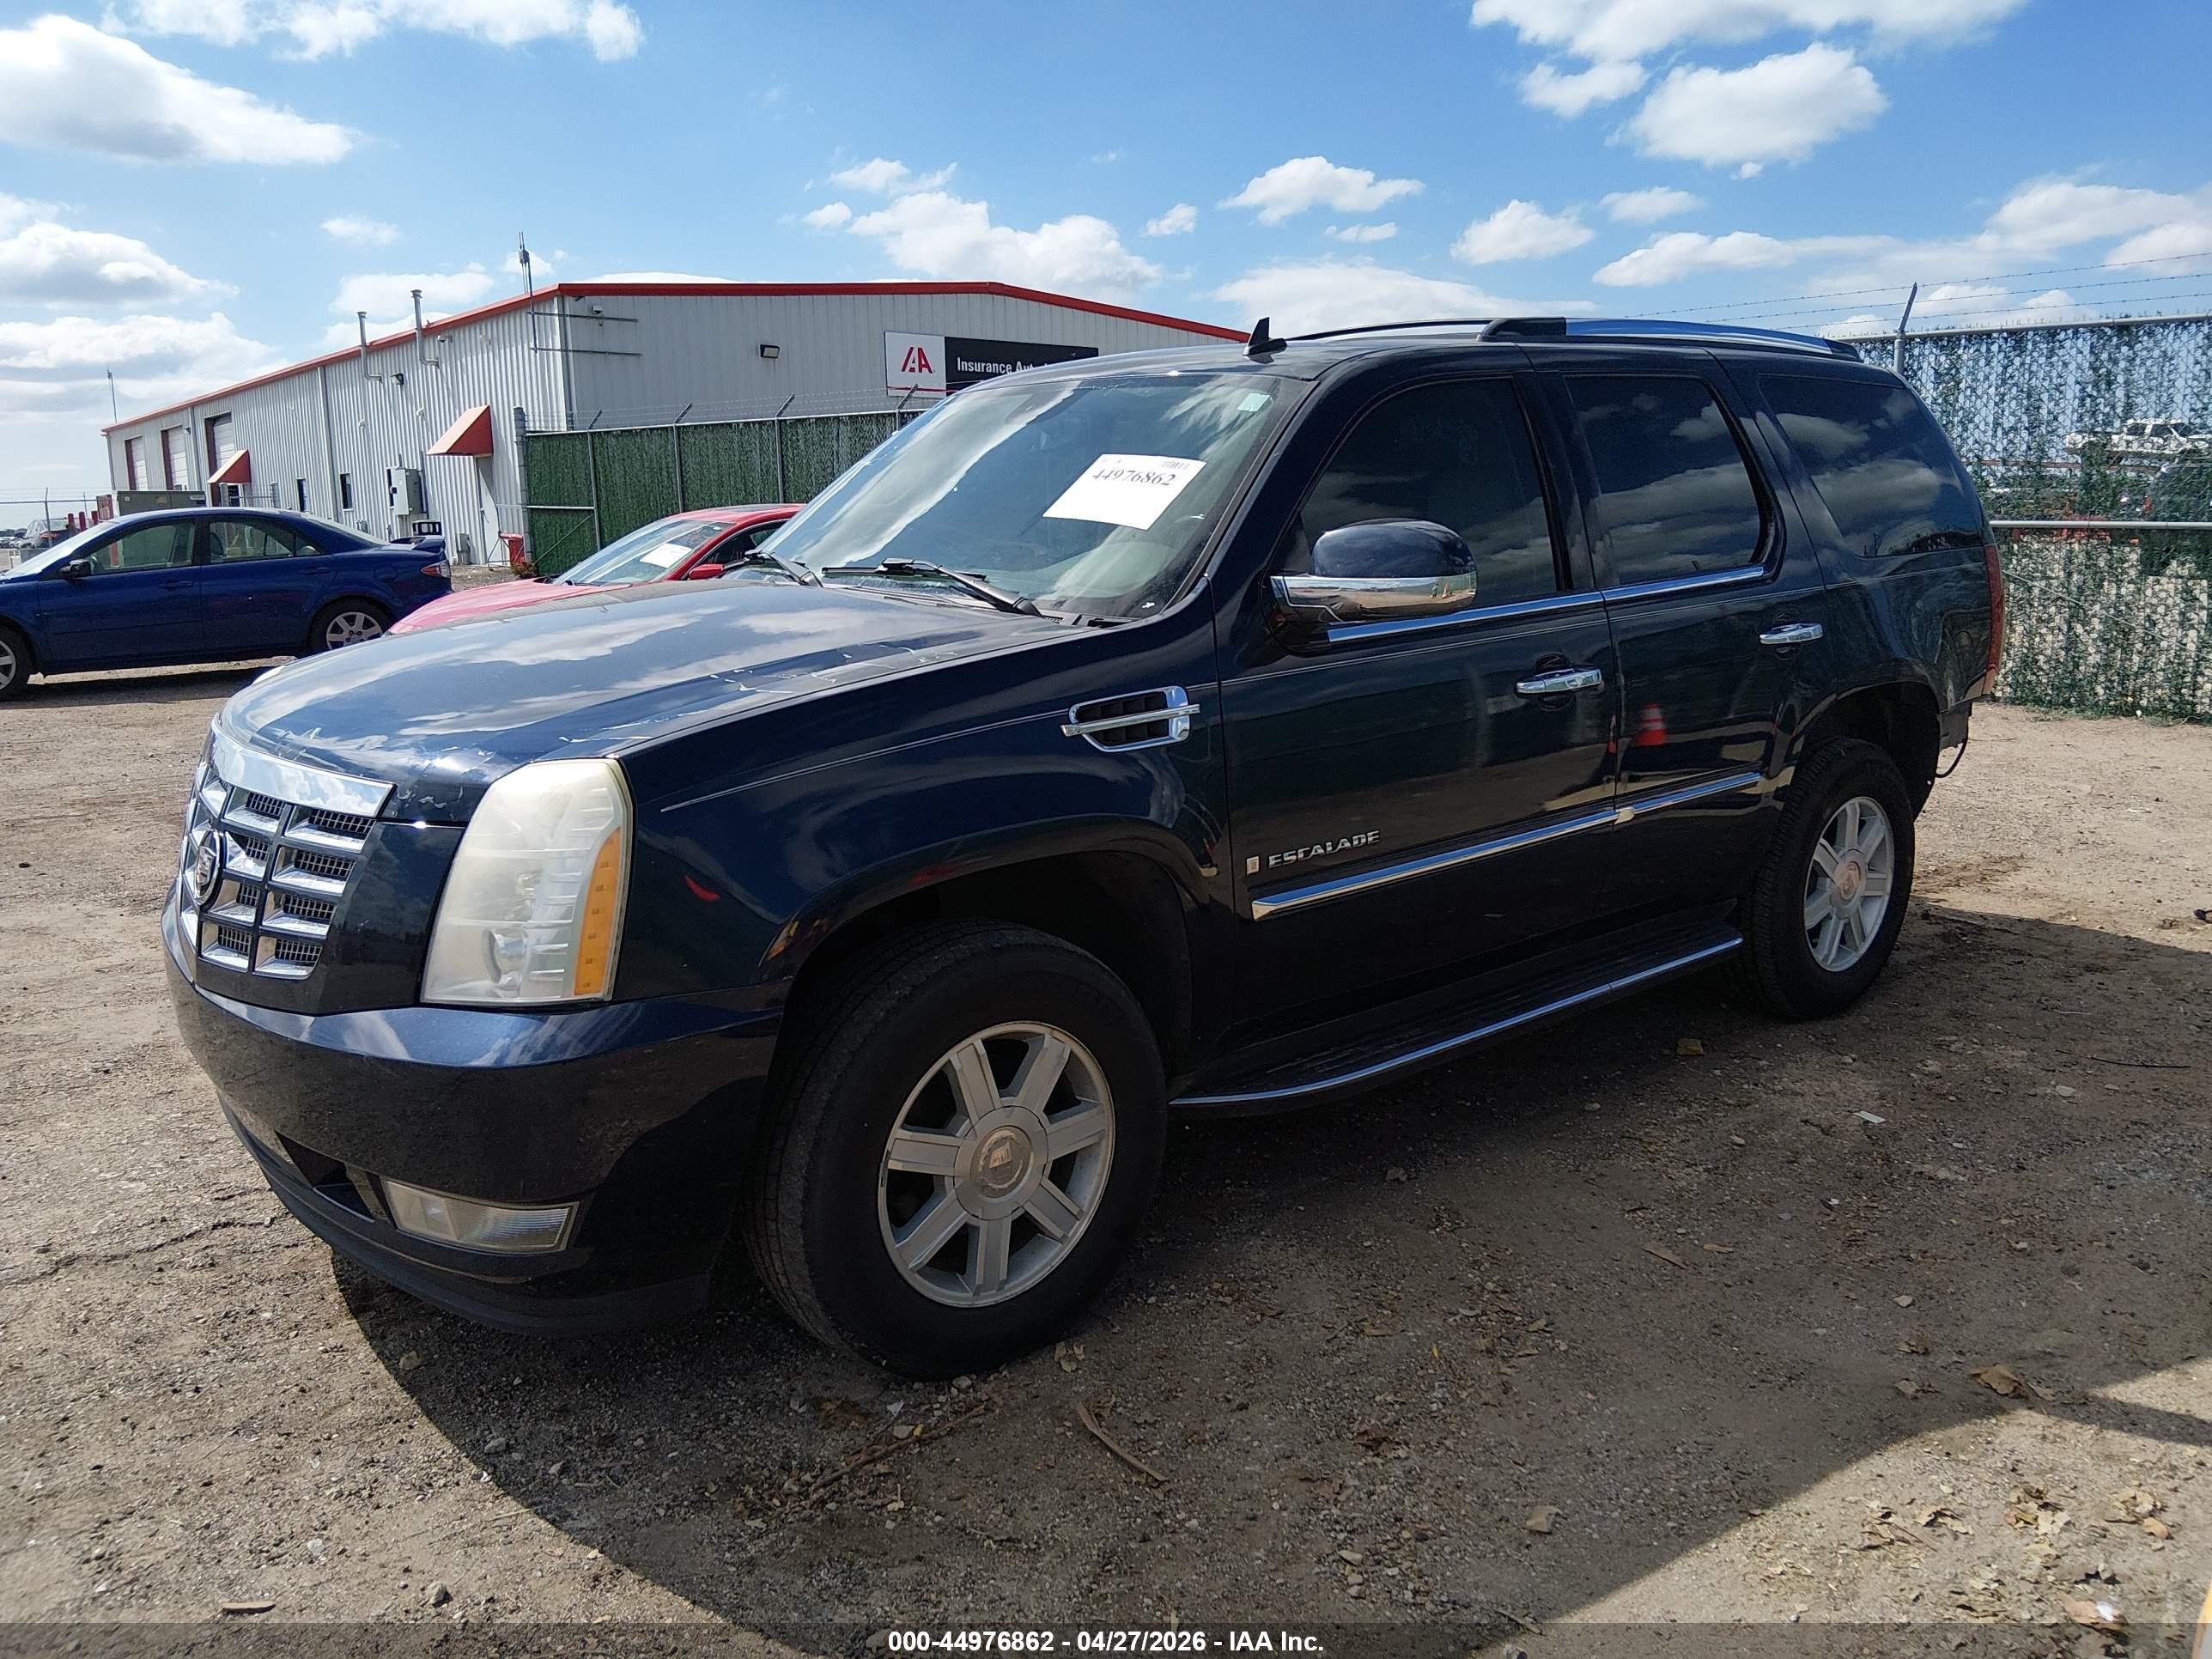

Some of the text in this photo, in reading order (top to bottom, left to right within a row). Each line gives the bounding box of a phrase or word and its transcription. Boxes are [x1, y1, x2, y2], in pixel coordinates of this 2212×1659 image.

[957, 356, 1012, 374] Insurance
[1091, 469, 1176, 486] 44976862
[1268, 830, 1380, 868] ESCALADE
